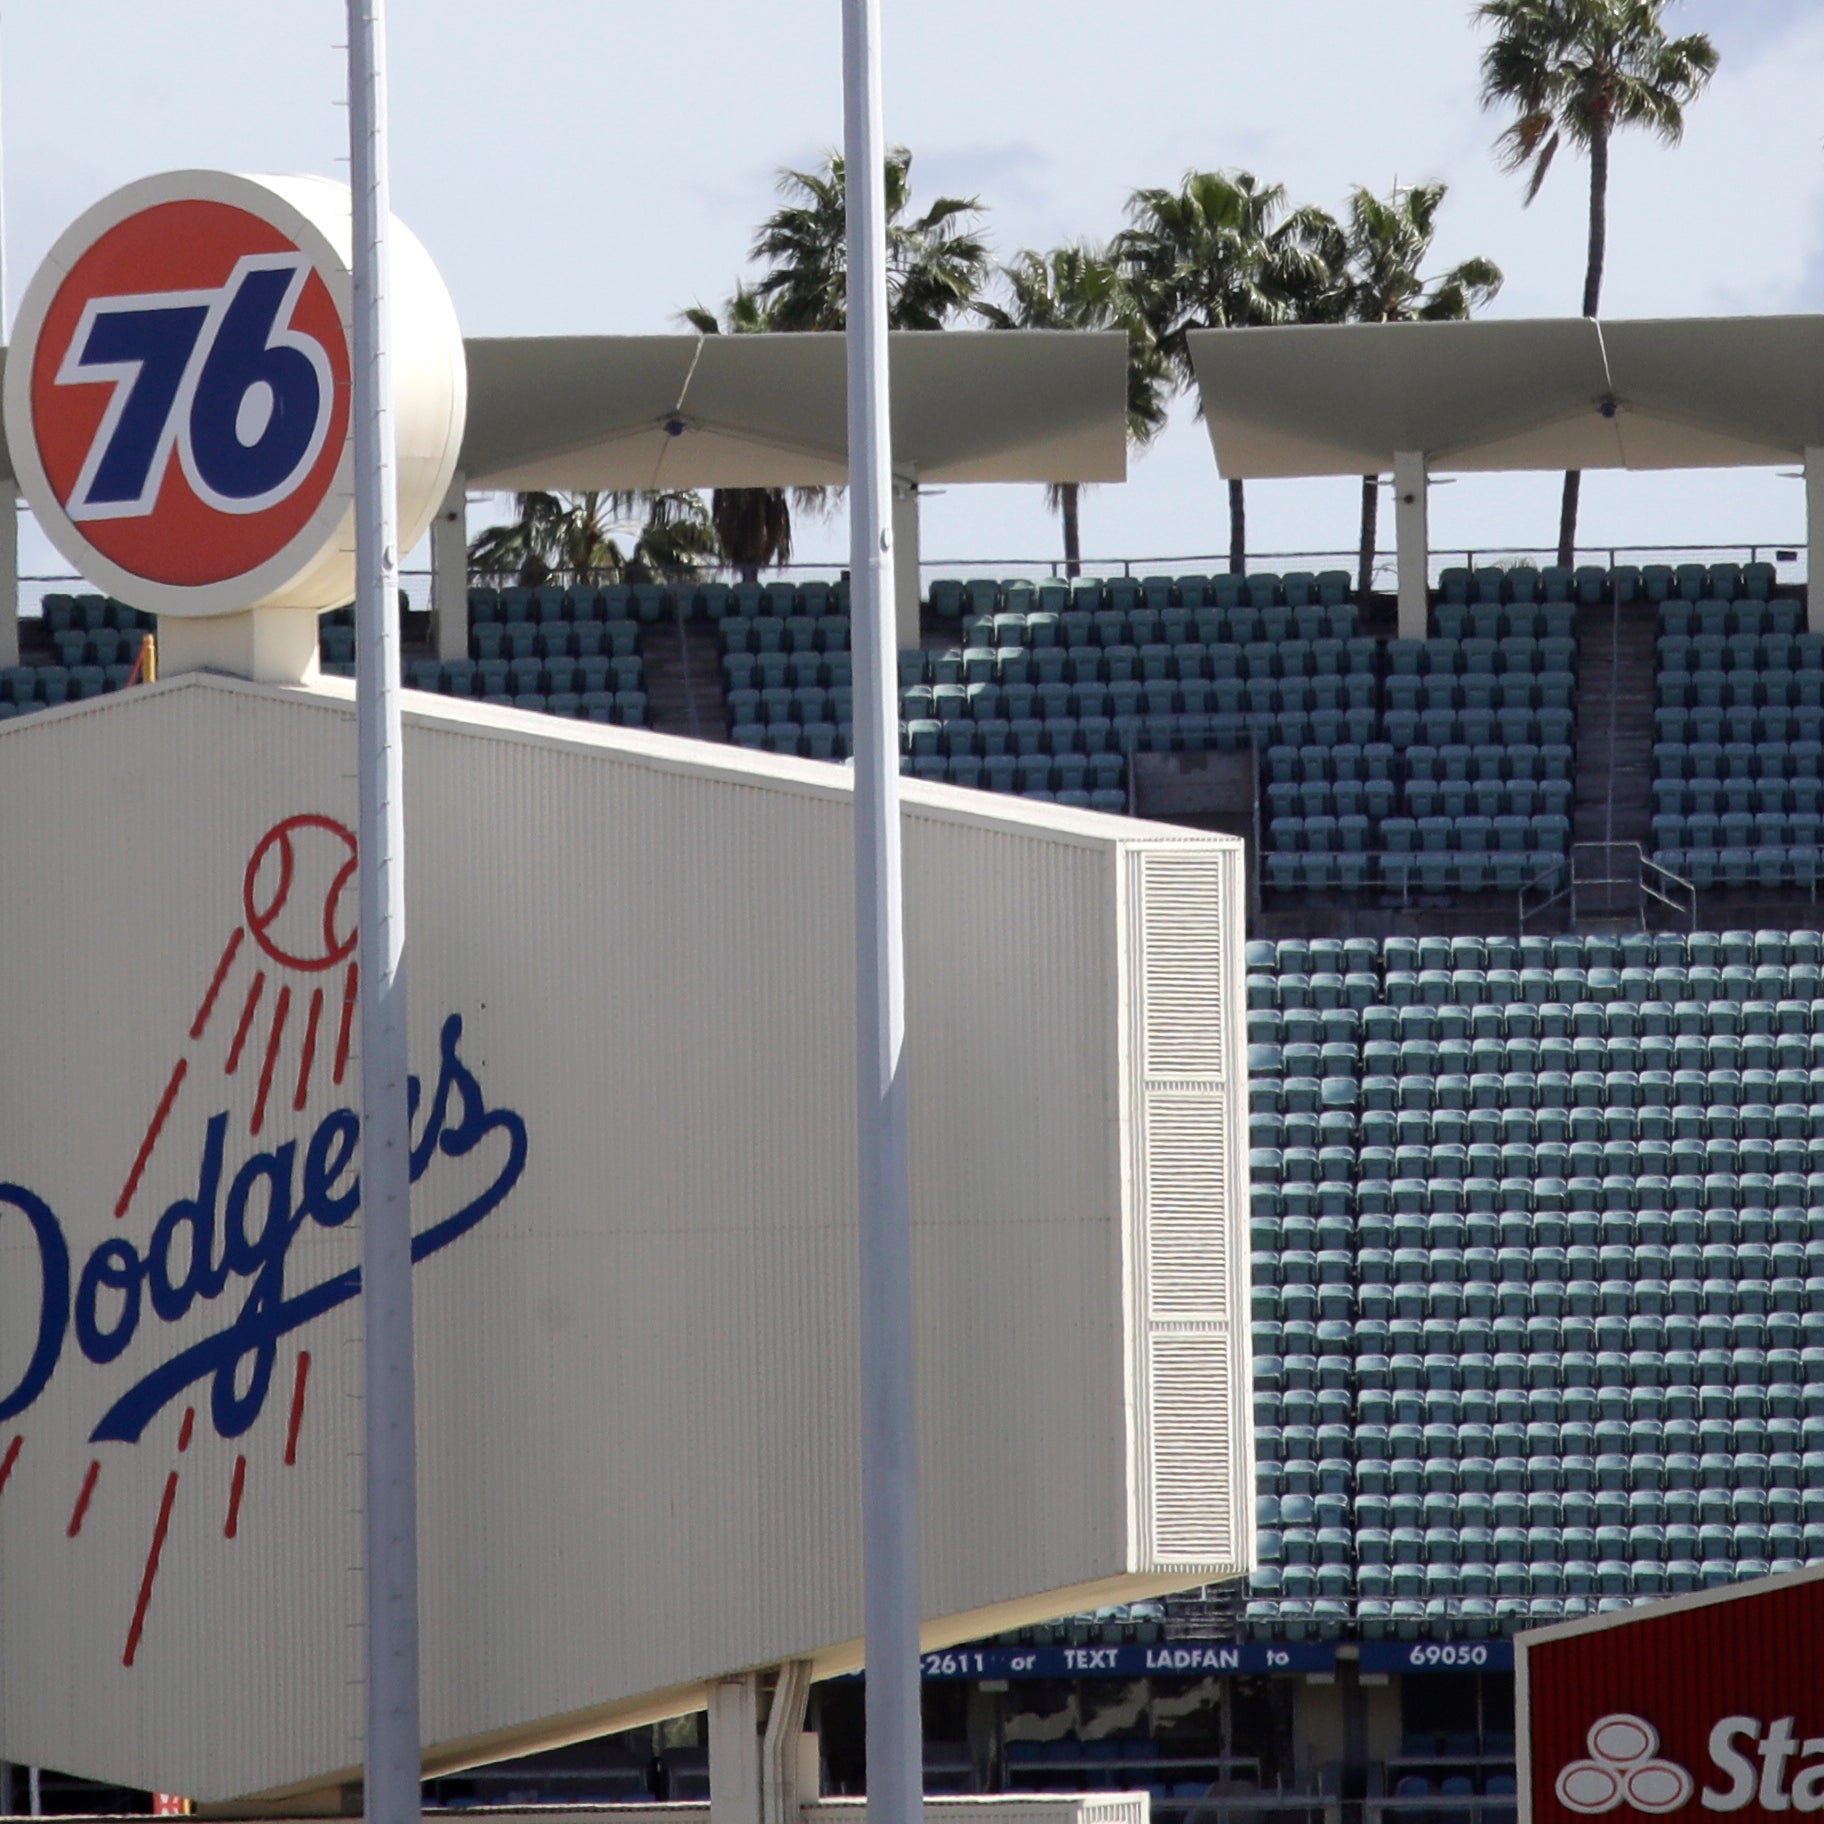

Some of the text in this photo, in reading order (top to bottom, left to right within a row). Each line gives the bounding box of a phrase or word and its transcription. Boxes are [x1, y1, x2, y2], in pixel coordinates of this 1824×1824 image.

[66, 259, 328, 511] 76
[1010, 1654, 1036, 1670] or
[1064, 1649, 1120, 1669] TEXT
[1145, 1648, 1239, 1669] LADFAN
[1266, 1649, 1290, 1666] to
[1408, 1645, 1488, 1666] 69050
